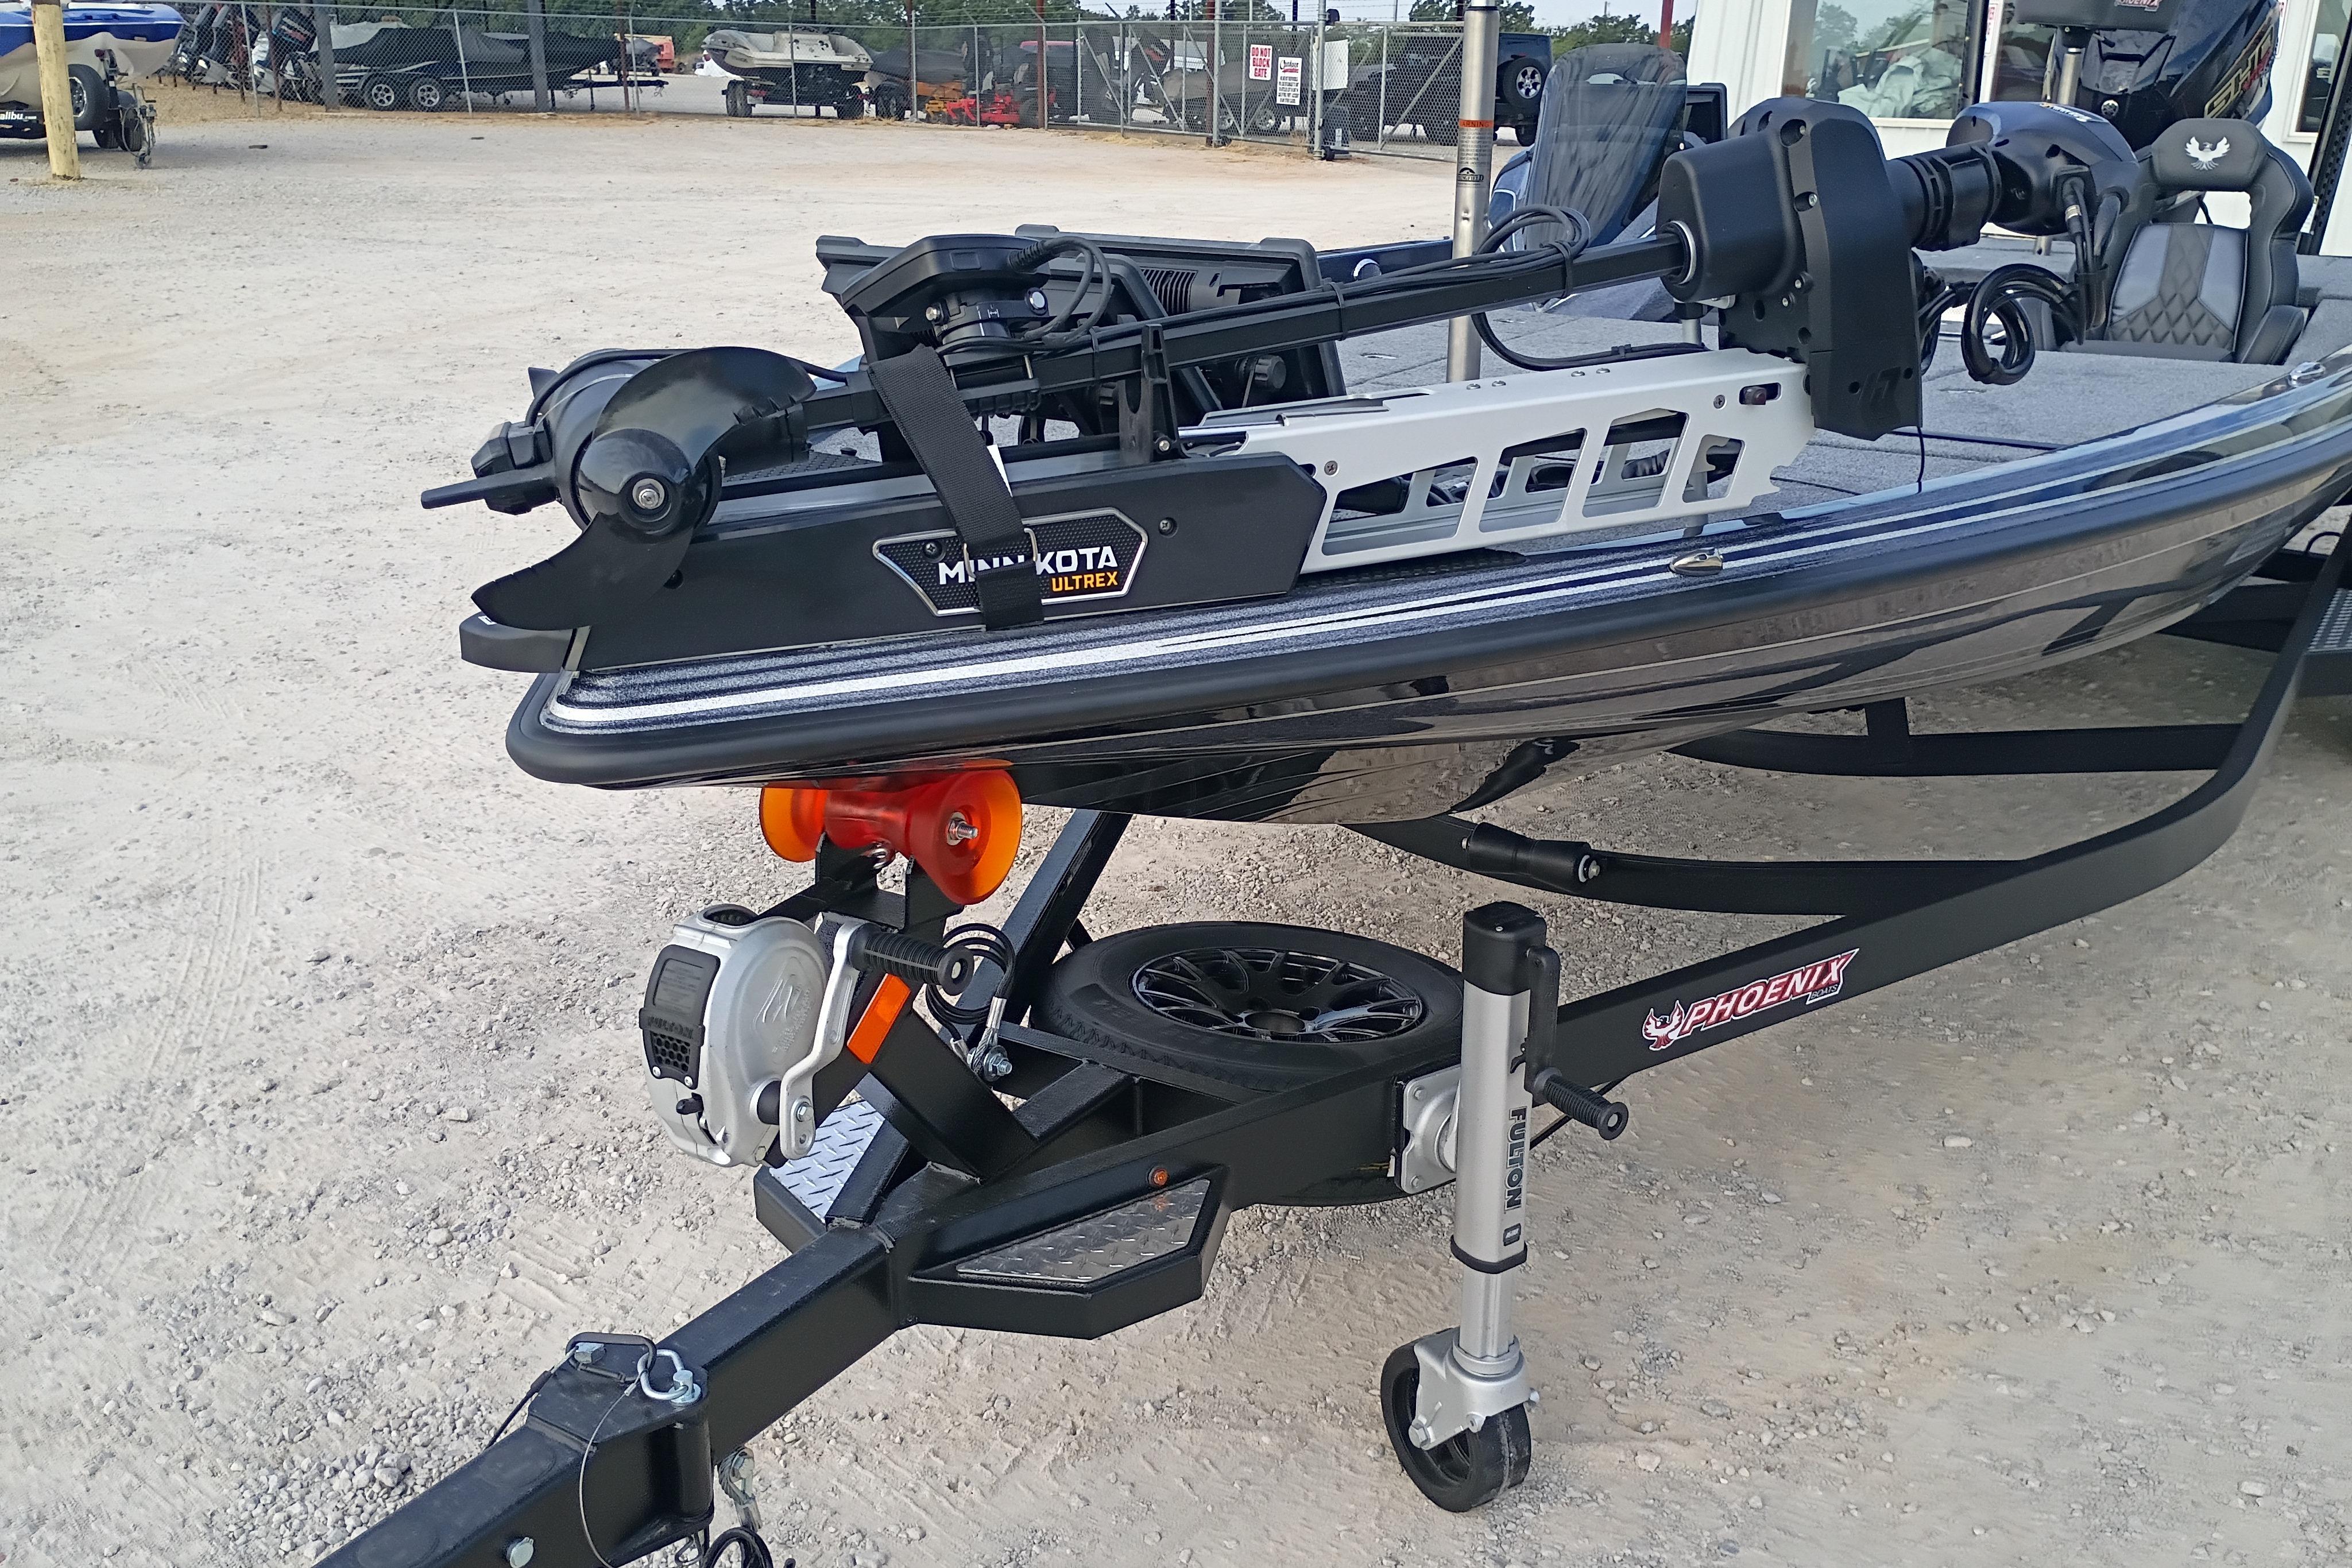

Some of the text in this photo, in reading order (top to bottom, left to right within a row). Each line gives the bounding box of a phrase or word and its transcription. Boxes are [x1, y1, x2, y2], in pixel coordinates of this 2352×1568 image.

[1252, 47, 1270, 57] DO NOT
[1252, 57, 1270, 67] BLOCK
[1254, 68, 1267, 78] GATE
[0, 111, 24, 120] alibu
[1035, 546, 1119, 575] KOTA
[1052, 571, 1119, 592] ULTREX
[1680, 957, 1850, 1033] PHOENIX
[1811, 985, 1838, 999] BOATS
[1505, 1106, 1526, 1210] FULTON
